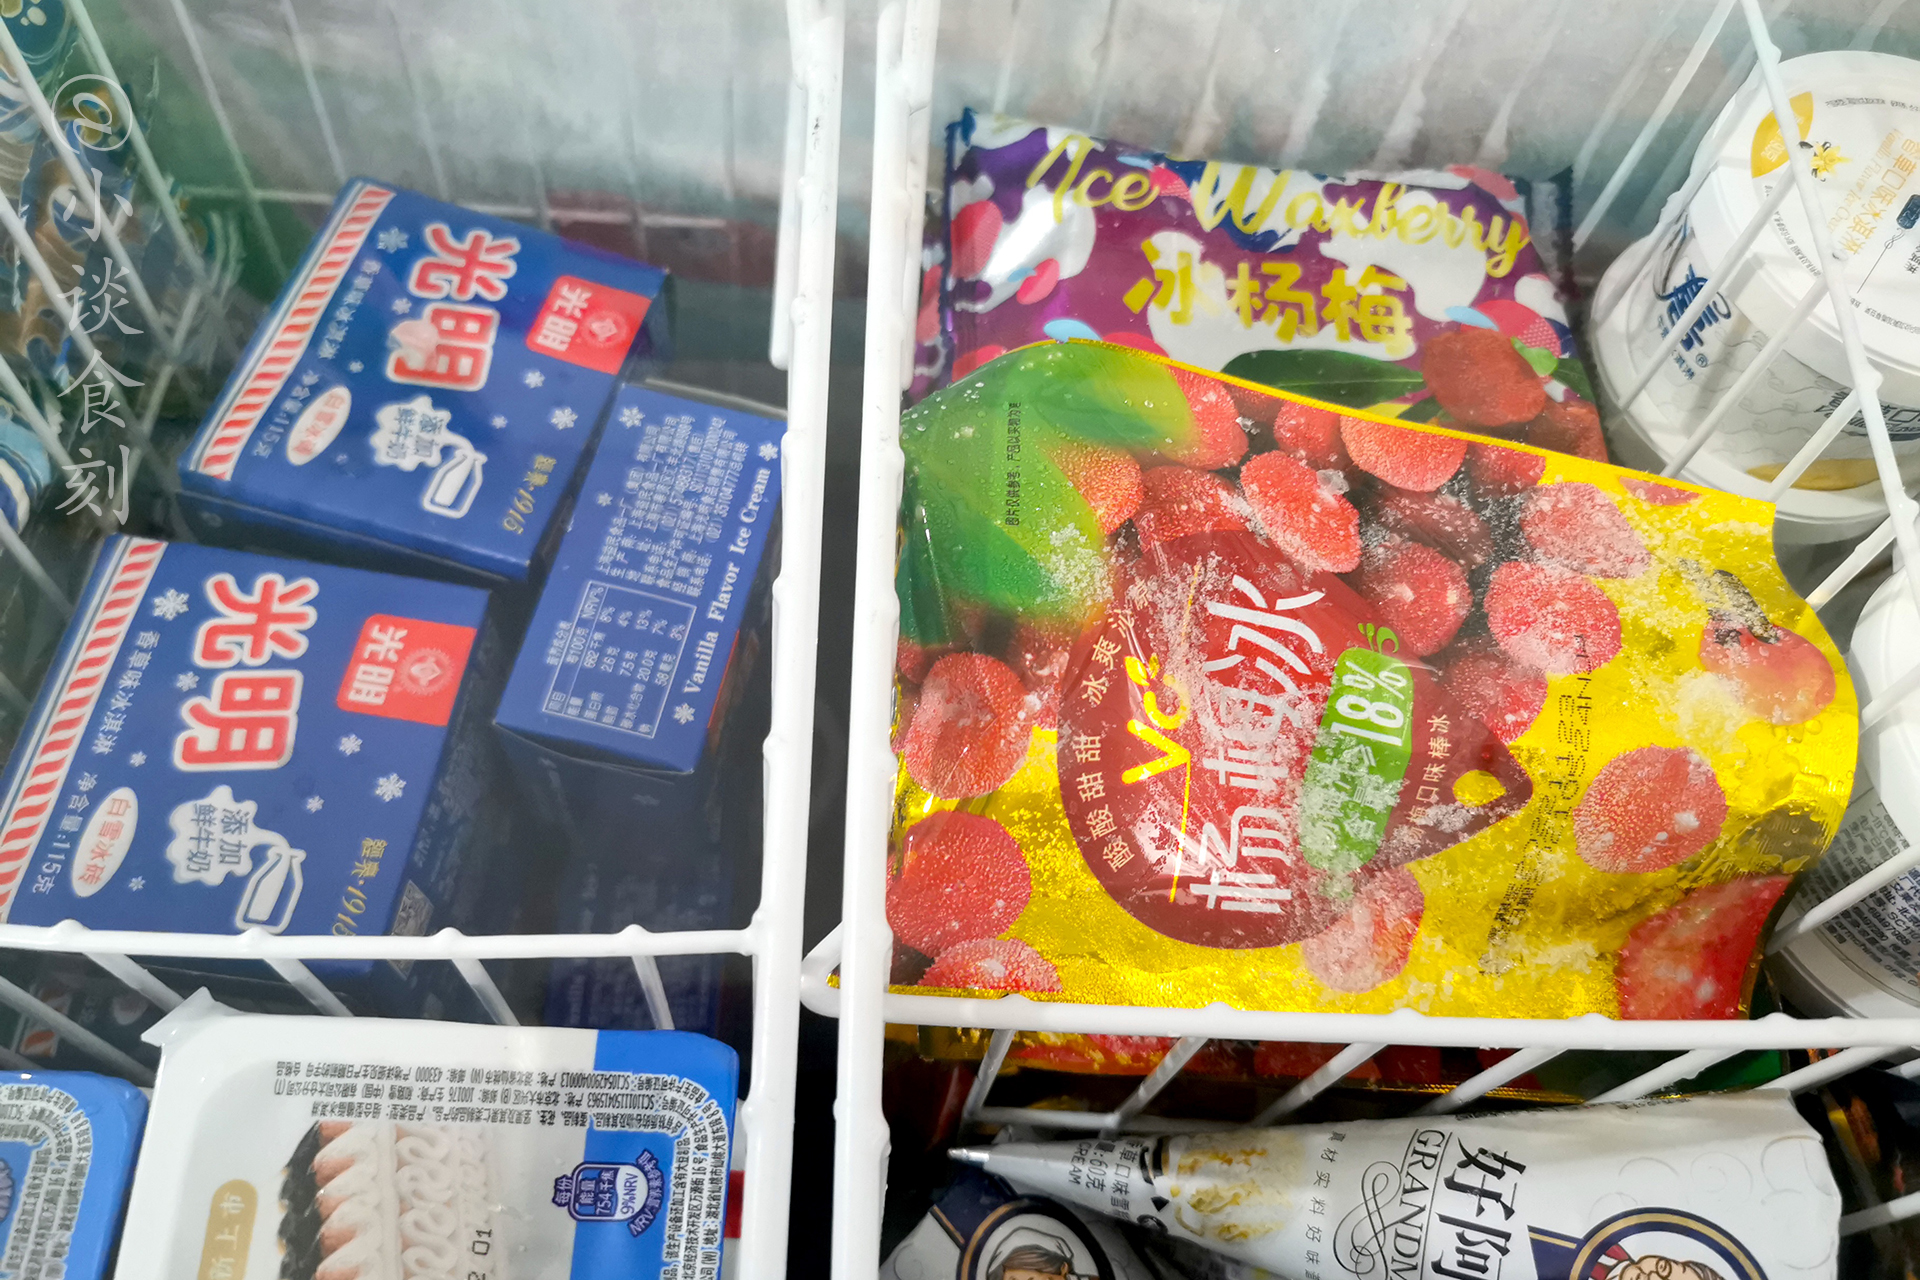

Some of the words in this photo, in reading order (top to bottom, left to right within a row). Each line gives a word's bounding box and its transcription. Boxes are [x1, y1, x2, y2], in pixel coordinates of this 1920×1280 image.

[1027, 135, 1160, 224] Ice
[1197, 160, 1530, 279] Waxberry
[1836, 136, 1920, 256] 香草口味冰淇淋
[385, 223, 521, 391] 光明
[535, 284, 591, 351] 光明
[1123, 238, 1415, 357] 冰杨梅
[740, 465, 772, 525] Cream
[729, 523, 753, 556] Ice
[707, 559, 742, 623] Flavor
[91, 630, 161, 757] 香草味冰淇淋
[173, 573, 319, 772] 光明
[347, 624, 409, 706] 光明
[684, 627, 720, 698] Vanilla
[1191, 575, 1329, 914] 杨梅冰
[185, 803, 214, 874] 鲜牛奶
[218, 807, 250, 866] 添加
[1076, 732, 1135, 873] 酸酸甜甜
[76, 796, 131, 886] 白雪冰砖
[554, 1173, 574, 1206] 每份
[577, 1176, 597, 1206] 能量
[594, 1166, 618, 1216] 754千焦
[619, 1171, 639, 1216] 9%NRV
[1067, 1140, 1091, 1186] CREAM
[209, 1191, 246, 1280] 新上市
[1434, 1137, 1525, 1280] 好阿
